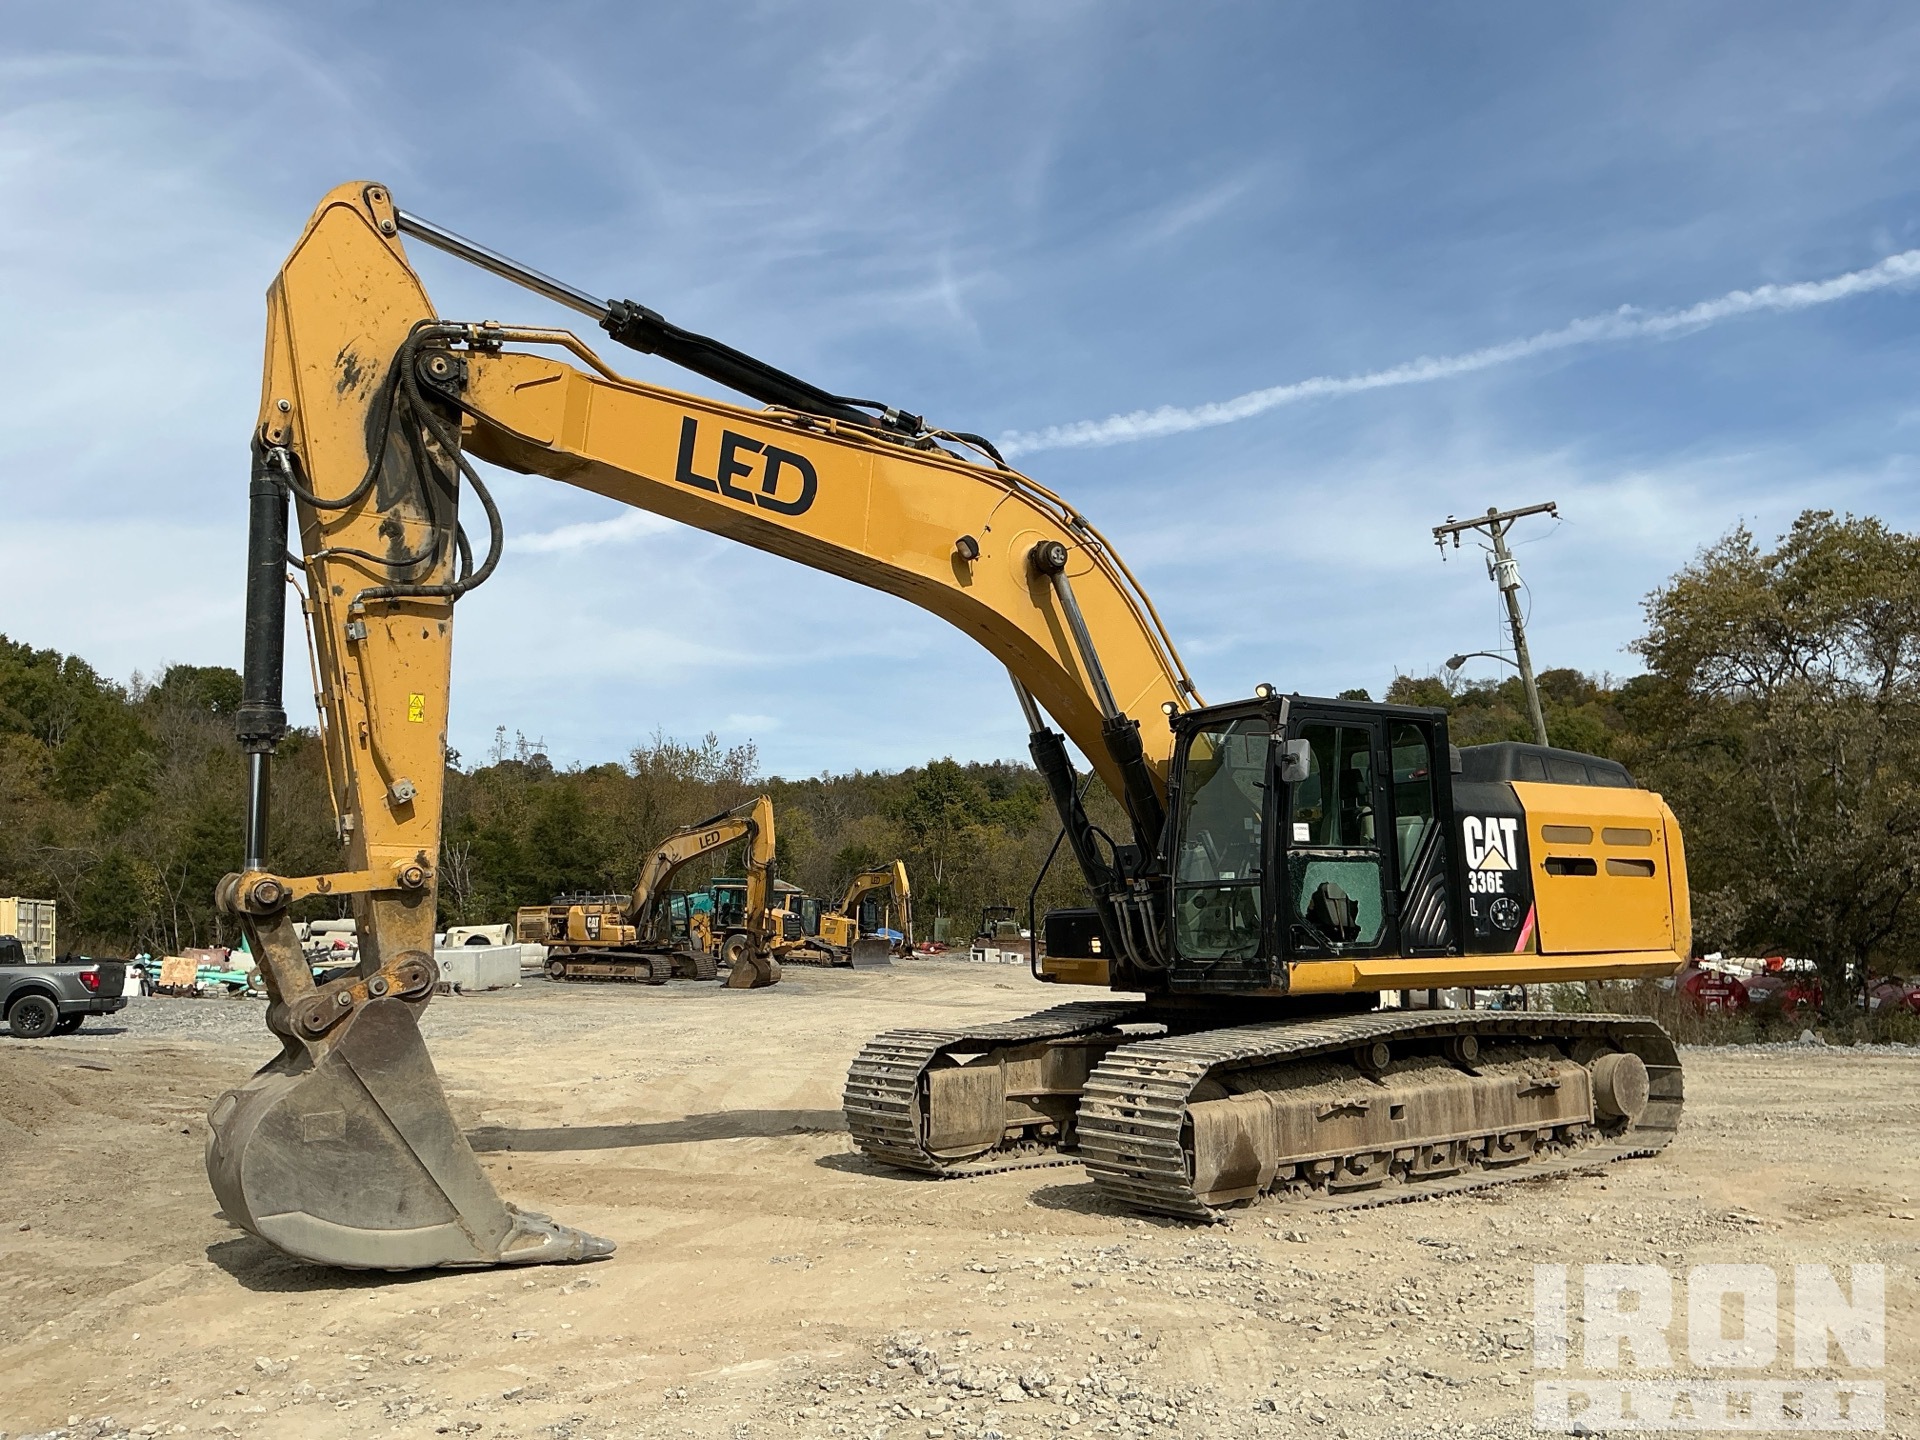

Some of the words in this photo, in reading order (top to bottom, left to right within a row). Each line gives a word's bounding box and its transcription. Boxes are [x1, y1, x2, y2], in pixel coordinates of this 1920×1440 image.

[675, 415, 818, 516] LED
[699, 831, 720, 849] LED
[1463, 815, 1518, 871] CAT
[1468, 871, 1504, 893] 336E
[587, 917, 599, 928] CAT
